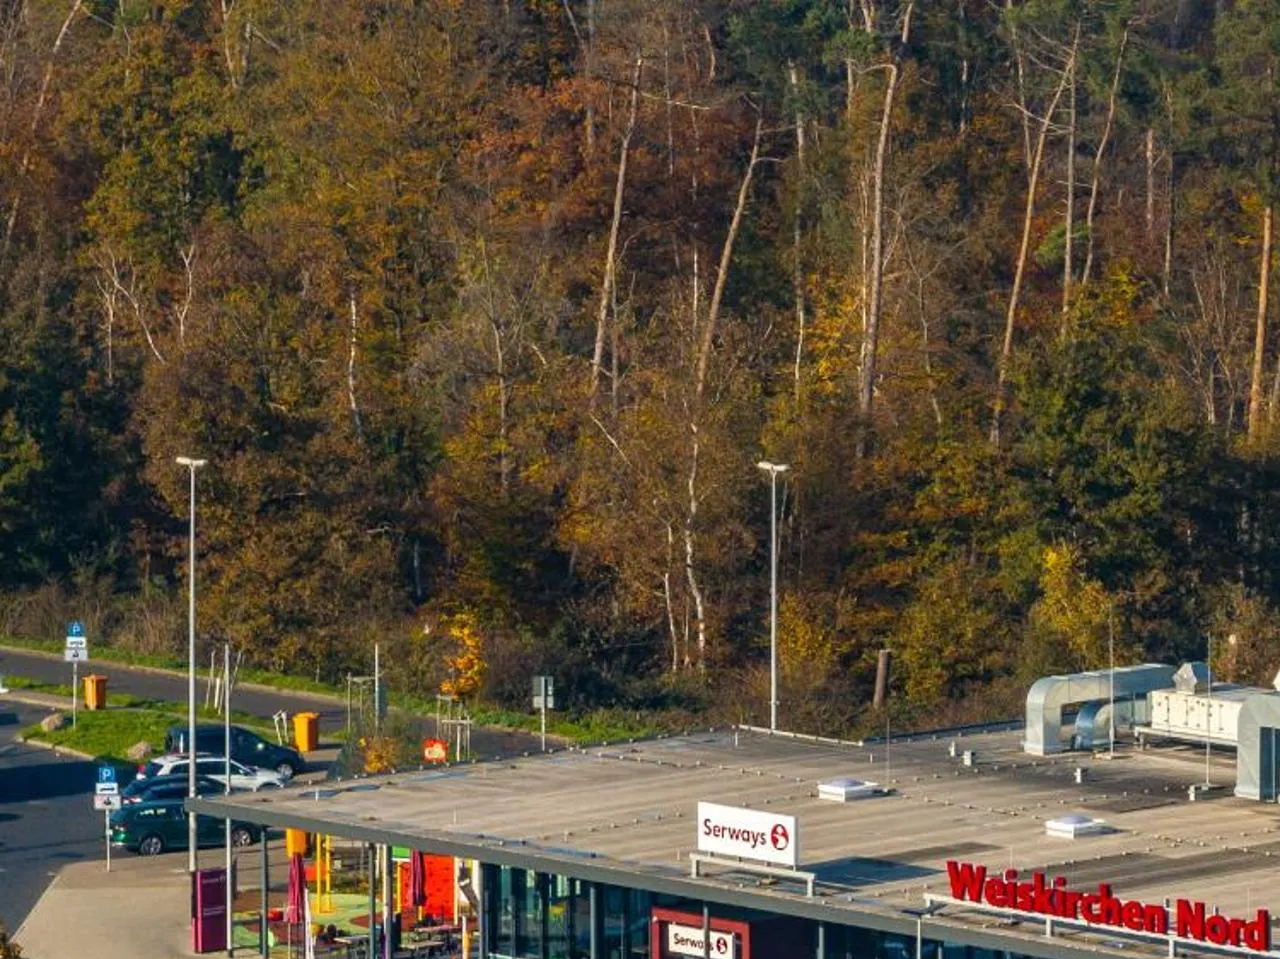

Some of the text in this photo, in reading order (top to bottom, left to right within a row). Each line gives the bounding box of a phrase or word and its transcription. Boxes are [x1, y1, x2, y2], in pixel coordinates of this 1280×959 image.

[102, 768, 111, 780] P
[703, 818, 767, 849] Serways
[946, 860, 1269, 951] Weiskirchen Nord
[673, 933, 714, 951] Serwas
